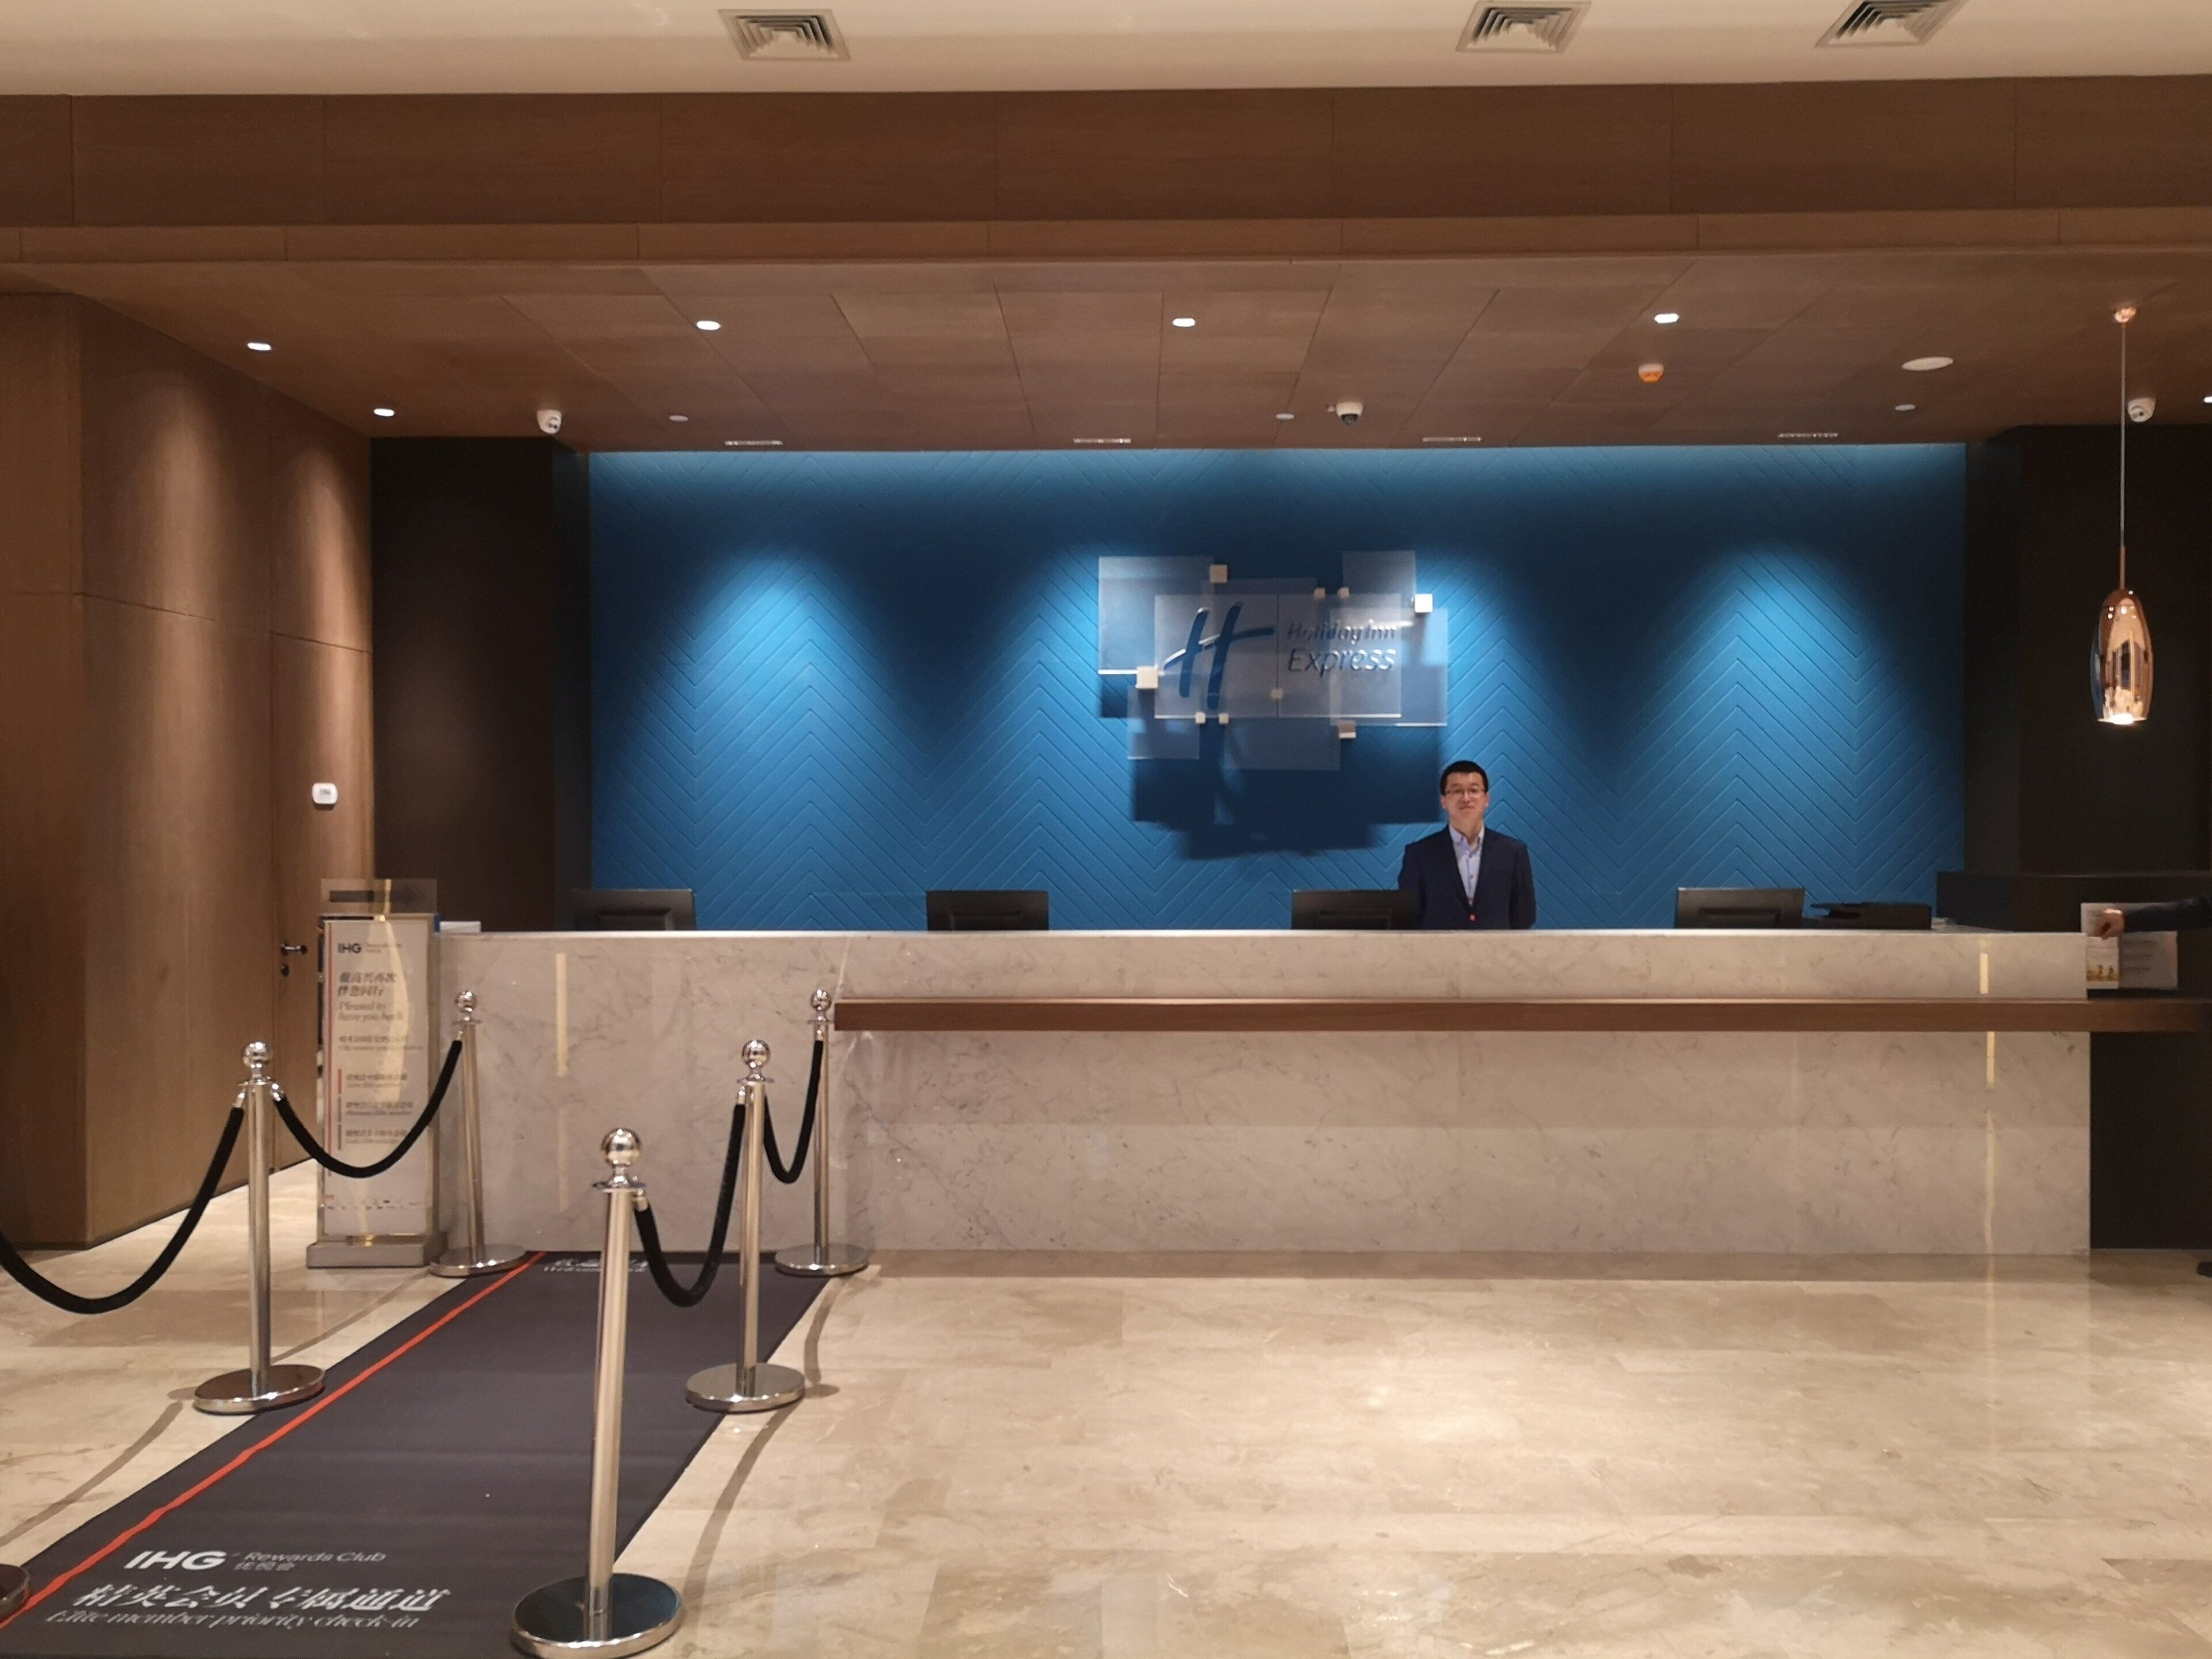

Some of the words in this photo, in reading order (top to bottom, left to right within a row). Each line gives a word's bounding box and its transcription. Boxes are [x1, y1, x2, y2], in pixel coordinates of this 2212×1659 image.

[1287, 619, 1364, 645] Holiday
[1365, 619, 1397, 639] Inn
[1287, 648, 1396, 677] Express
[337, 943, 362, 954] IHG
[123, 1550, 228, 1571] IHG
[244, 1552, 335, 1562] Rewards
[336, 1552, 387, 1562] Club
[207, 1613, 313, 1630] priority
